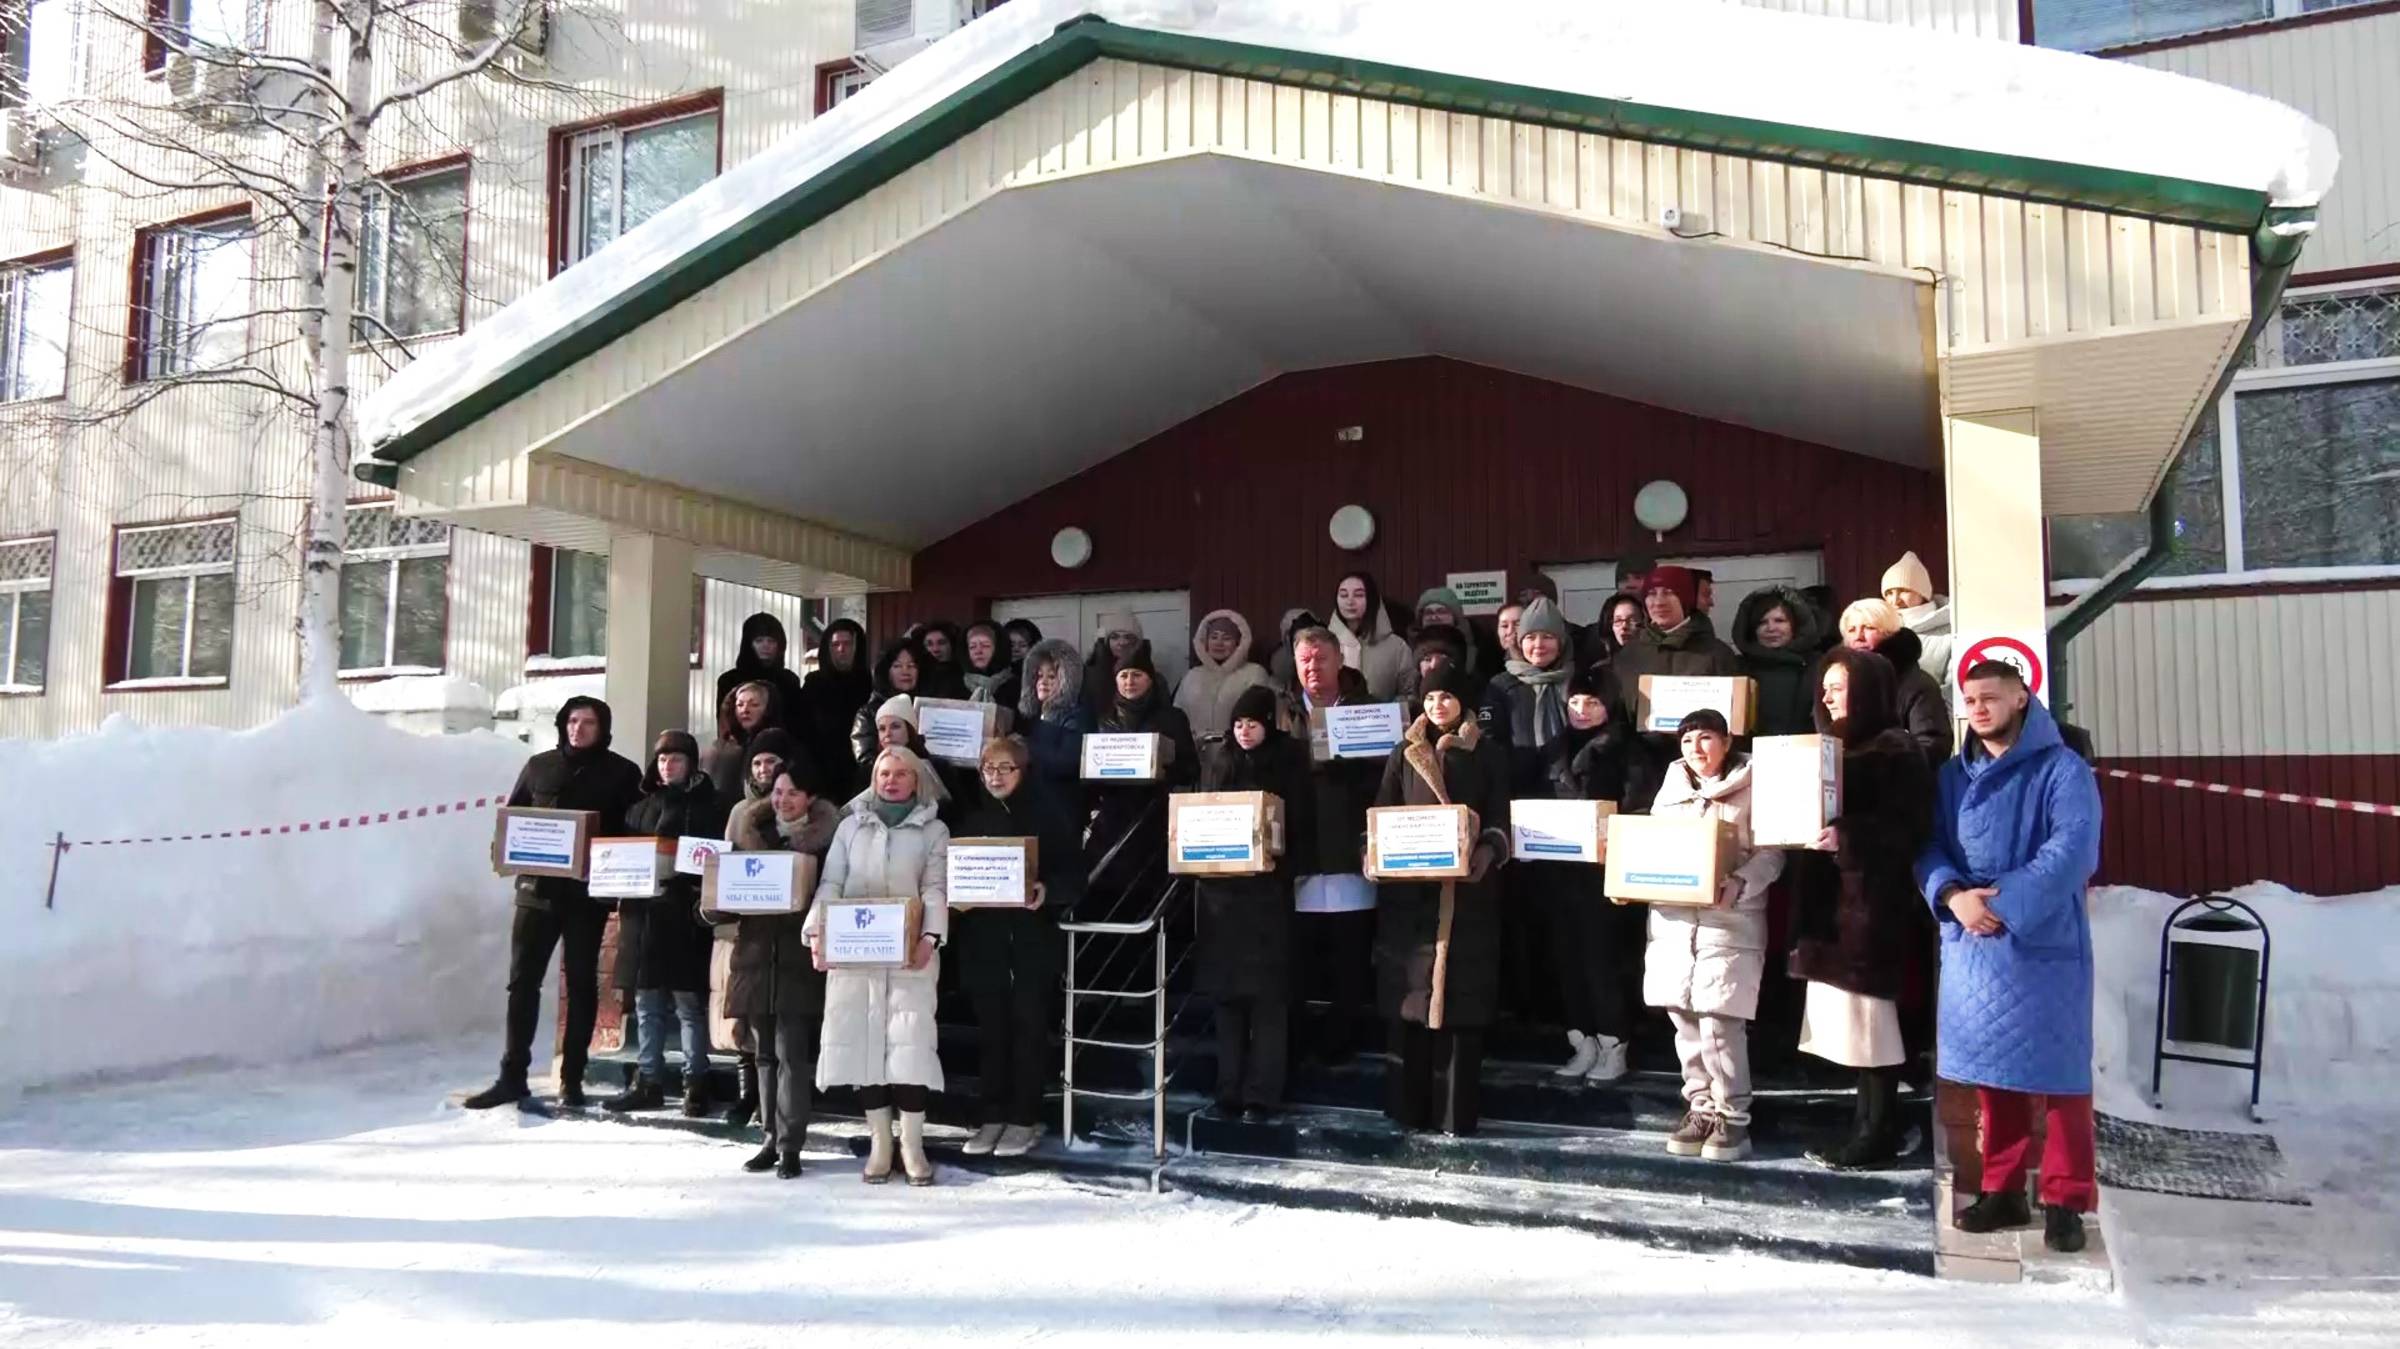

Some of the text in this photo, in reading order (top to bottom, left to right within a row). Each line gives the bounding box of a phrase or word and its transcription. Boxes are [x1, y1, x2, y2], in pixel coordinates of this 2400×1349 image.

[726, 893, 742, 902] МЫ
[743, 893, 750, 902] С
[834, 946, 851, 955] МЫ
[854, 946, 862, 954] С
